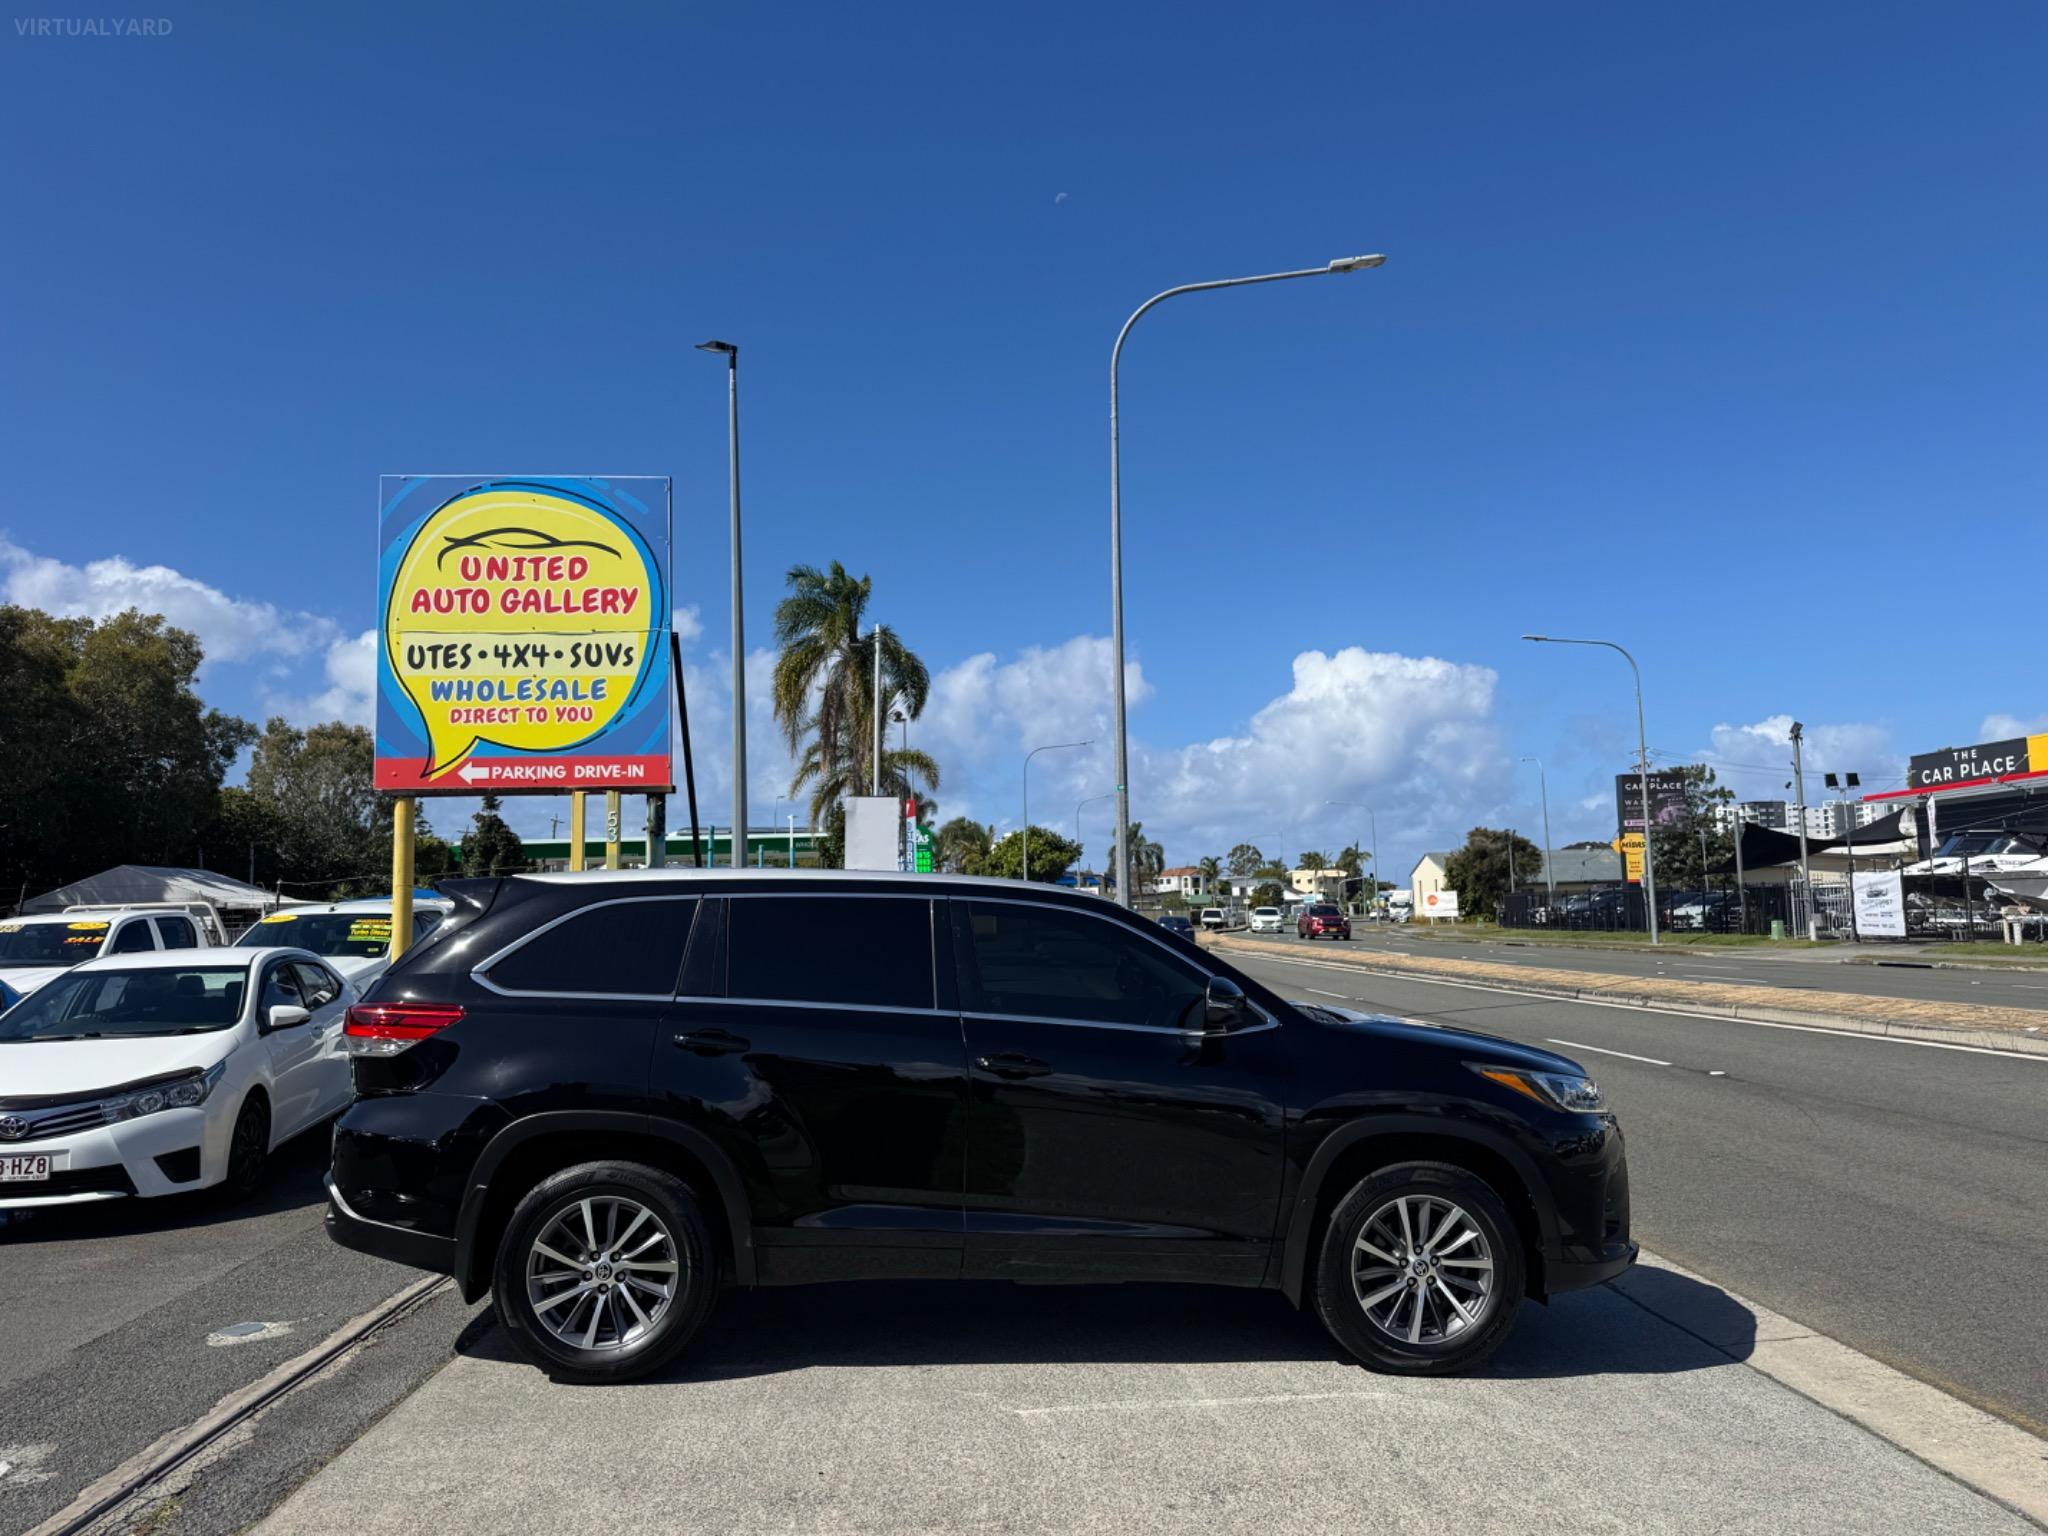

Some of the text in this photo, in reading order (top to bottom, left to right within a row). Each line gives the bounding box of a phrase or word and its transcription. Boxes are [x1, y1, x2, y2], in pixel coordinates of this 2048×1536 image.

[460, 555, 588, 582] UNITED
[411, 587, 639, 615] AUTO GALLERY
[407, 642, 634, 670] UTES 4X4 SUVs
[431, 678, 607, 702] WHOLESALE
[450, 707, 593, 724] DIRECT TO YOU
[1952, 749, 1977, 761] THE
[492, 764, 645, 780] PARKING DRIVE-IN
[1921, 755, 2016, 784] CAR PLACE
[1649, 782, 1682, 790] PLACE
